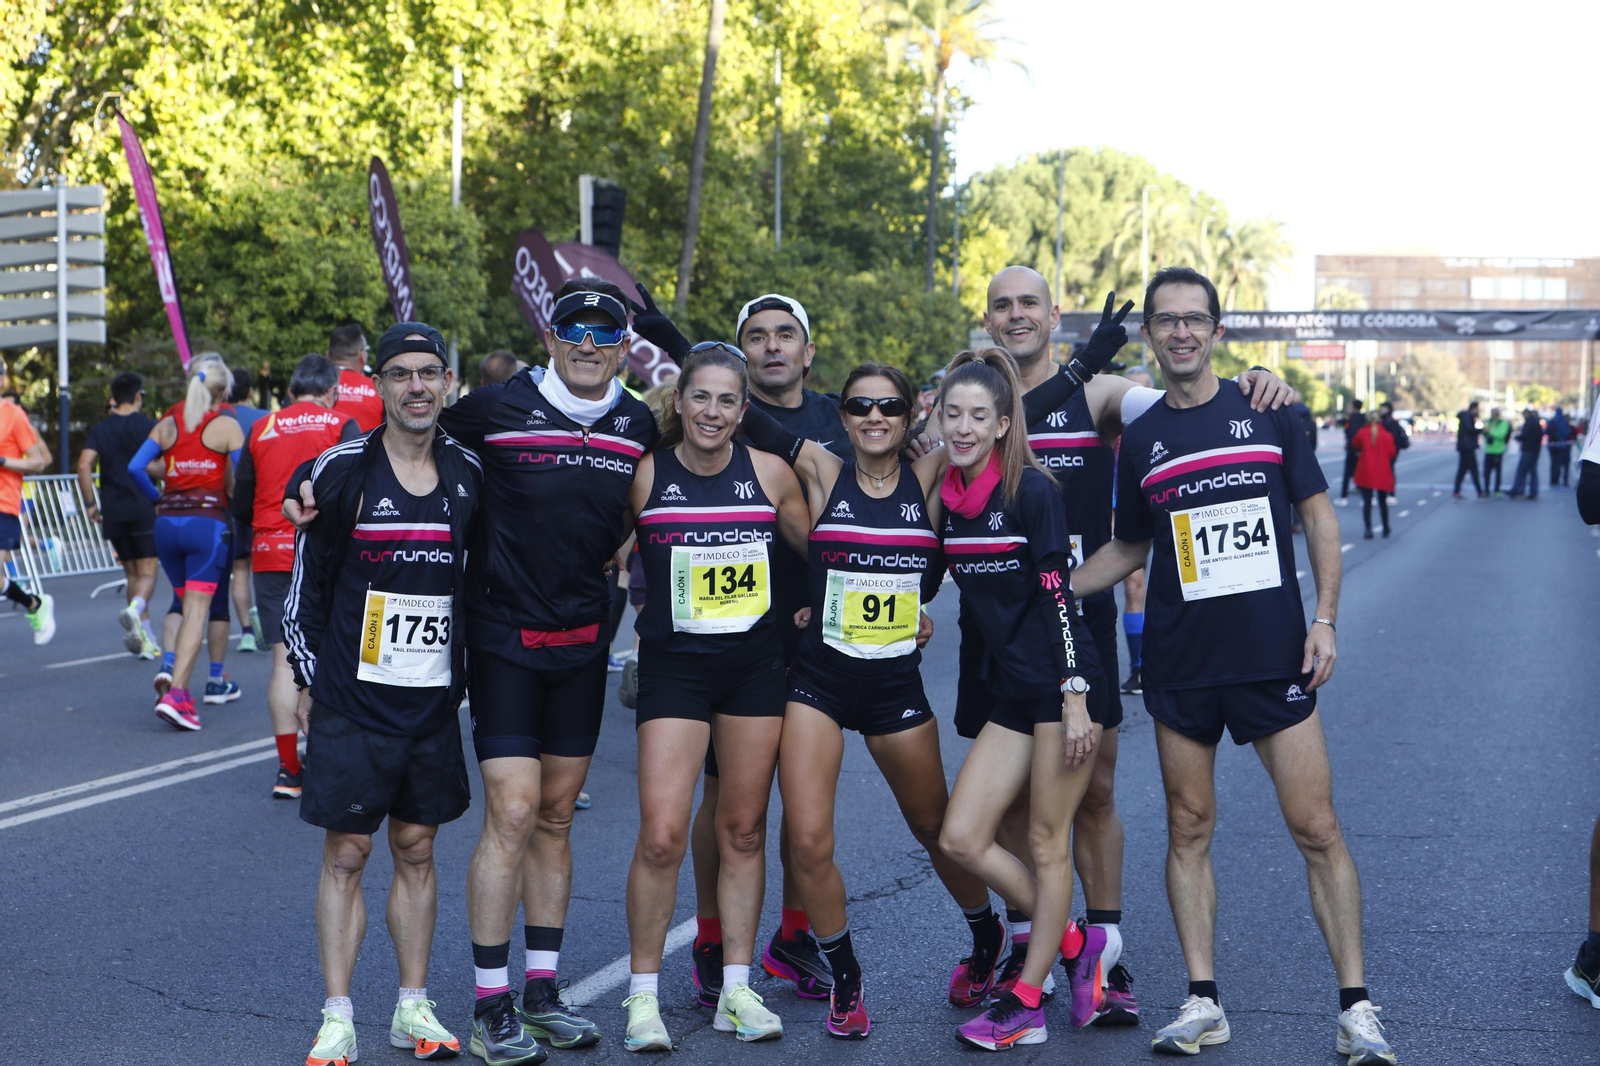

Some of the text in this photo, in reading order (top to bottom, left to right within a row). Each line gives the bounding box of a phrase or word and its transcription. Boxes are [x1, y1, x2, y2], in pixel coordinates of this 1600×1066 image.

[1263, 311, 1338, 328] MARATÓN
[1340, 314, 1361, 327] DE
[1363, 312, 1438, 328] CÓRDOBA
[338, 383, 376, 397] ticalia
[277, 413, 340, 427] verticalia
[175, 459, 217, 470] verticalia
[519, 452, 633, 475] runrundata
[1150, 470, 1267, 506] runrundata
[831, 511, 855, 519] austral
[1201, 506, 1239, 519] IMDECO
[650, 529, 773, 544] runrundata
[1195, 518, 1270, 556] 1754
[360, 548, 455, 564] runrunda
[703, 551, 740, 560] IMDECO
[821, 551, 928, 569] runrundata
[1181, 538, 1191, 567] CAJÓN
[1212, 555, 1233, 563] ANTONIO
[949, 558, 1021, 573] nrundata
[703, 564, 757, 596] 134
[856, 579, 894, 588] IMDECO
[678, 575, 686, 605] CAJÓN
[398, 598, 435, 608] IMDECO
[862, 594, 896, 622] 91
[829, 599, 838, 627] CAJÓN
[367, 620, 378, 650] CAJÓN
[386, 613, 451, 646] 1753
